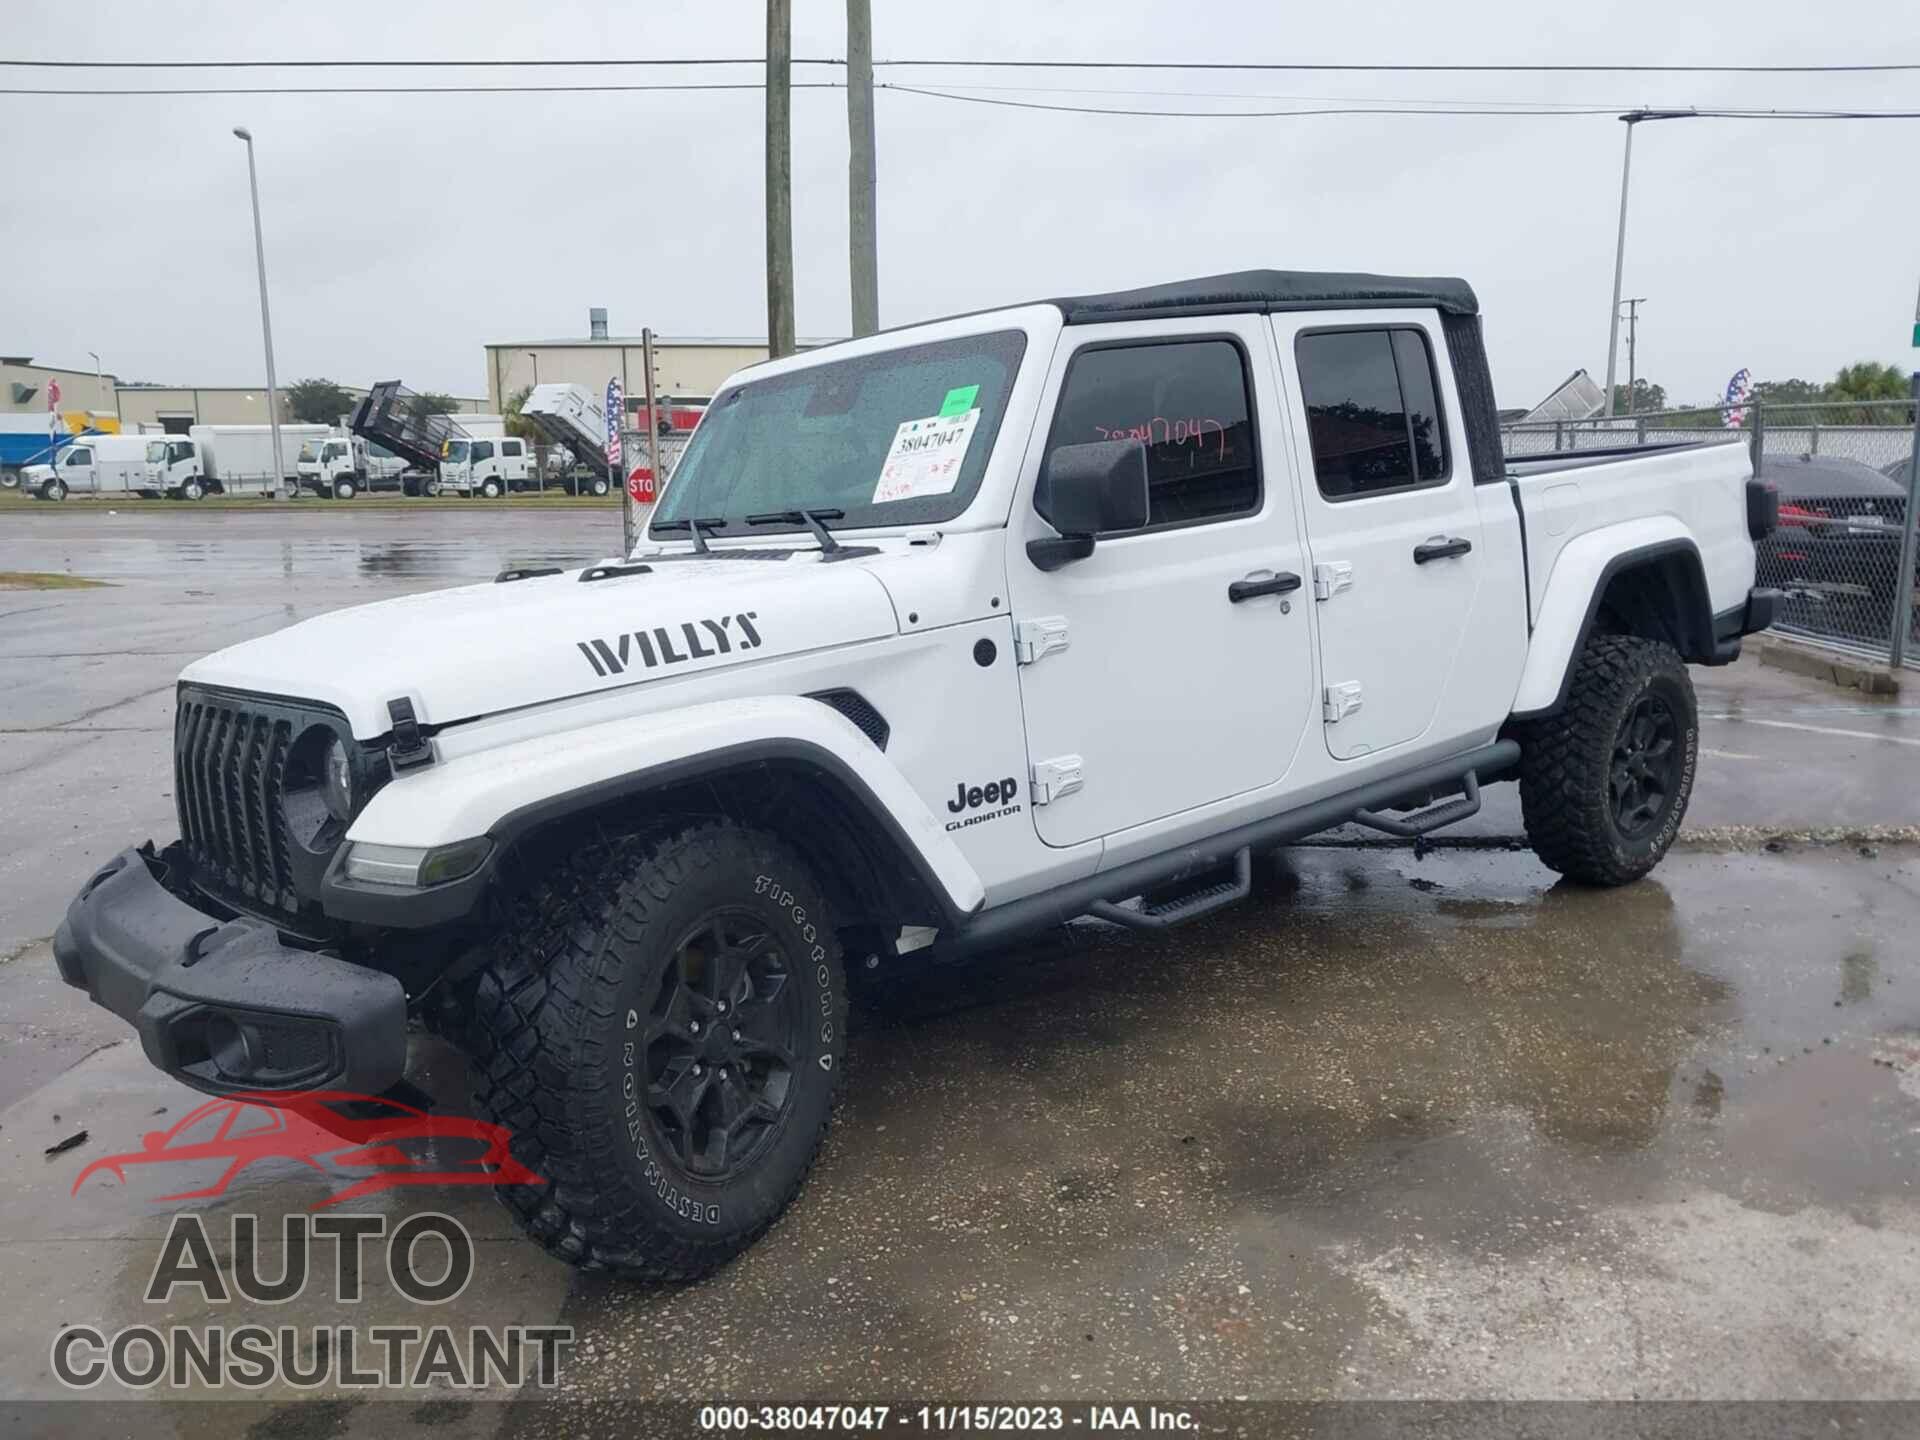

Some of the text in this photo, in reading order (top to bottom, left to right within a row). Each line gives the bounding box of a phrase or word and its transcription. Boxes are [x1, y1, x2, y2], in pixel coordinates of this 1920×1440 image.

[897, 428, 965, 455] 38047047
[630, 479, 654, 493] STO
[576, 611, 762, 677] WILLYS
[947, 777, 1018, 813] Jeep
[945, 804, 1022, 832] GLADIATOR
[754, 874, 834, 1044] Firestone
[623, 1042, 721, 1225] DESTINATION
